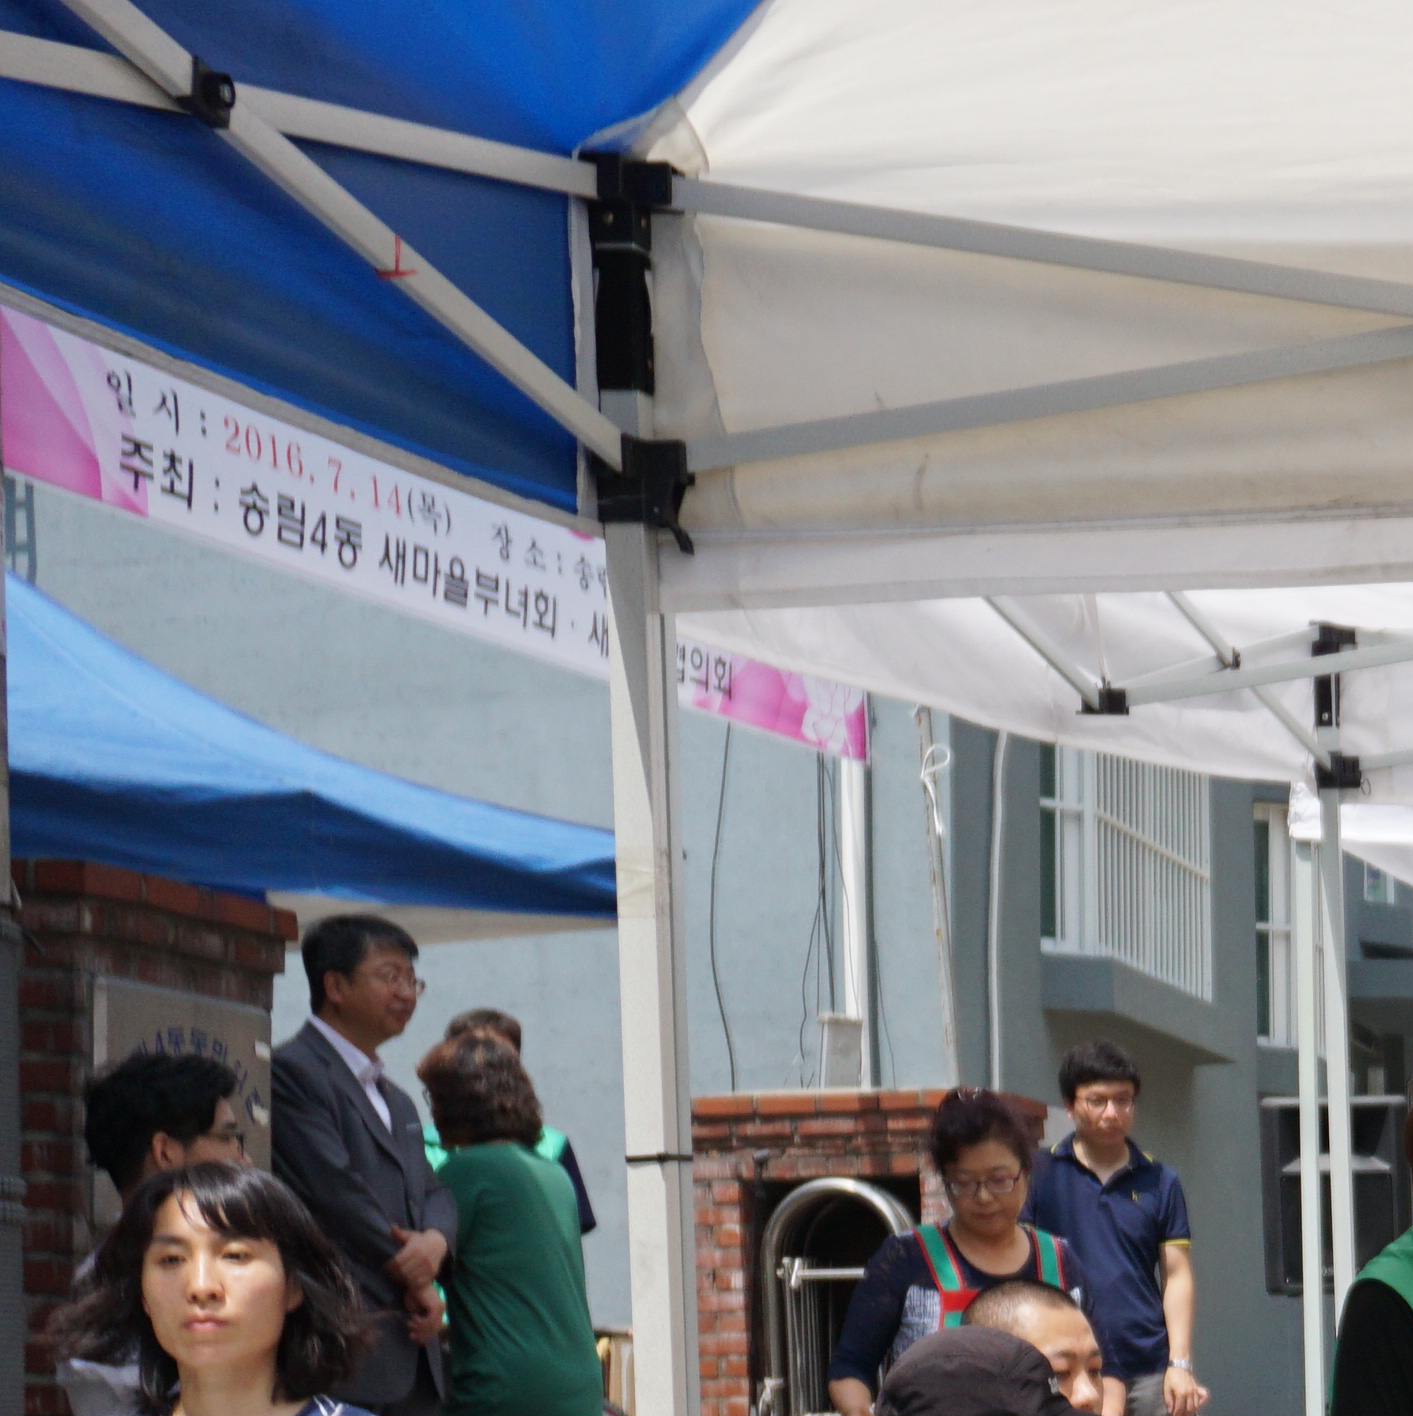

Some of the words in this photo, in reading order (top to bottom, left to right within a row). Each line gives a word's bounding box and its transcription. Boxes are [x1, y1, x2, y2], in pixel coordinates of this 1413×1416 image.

[119, 433, 193, 512] 주최
[238, 480, 363, 570] 송림4동
[378, 531, 557, 640] 새마을부녀회
